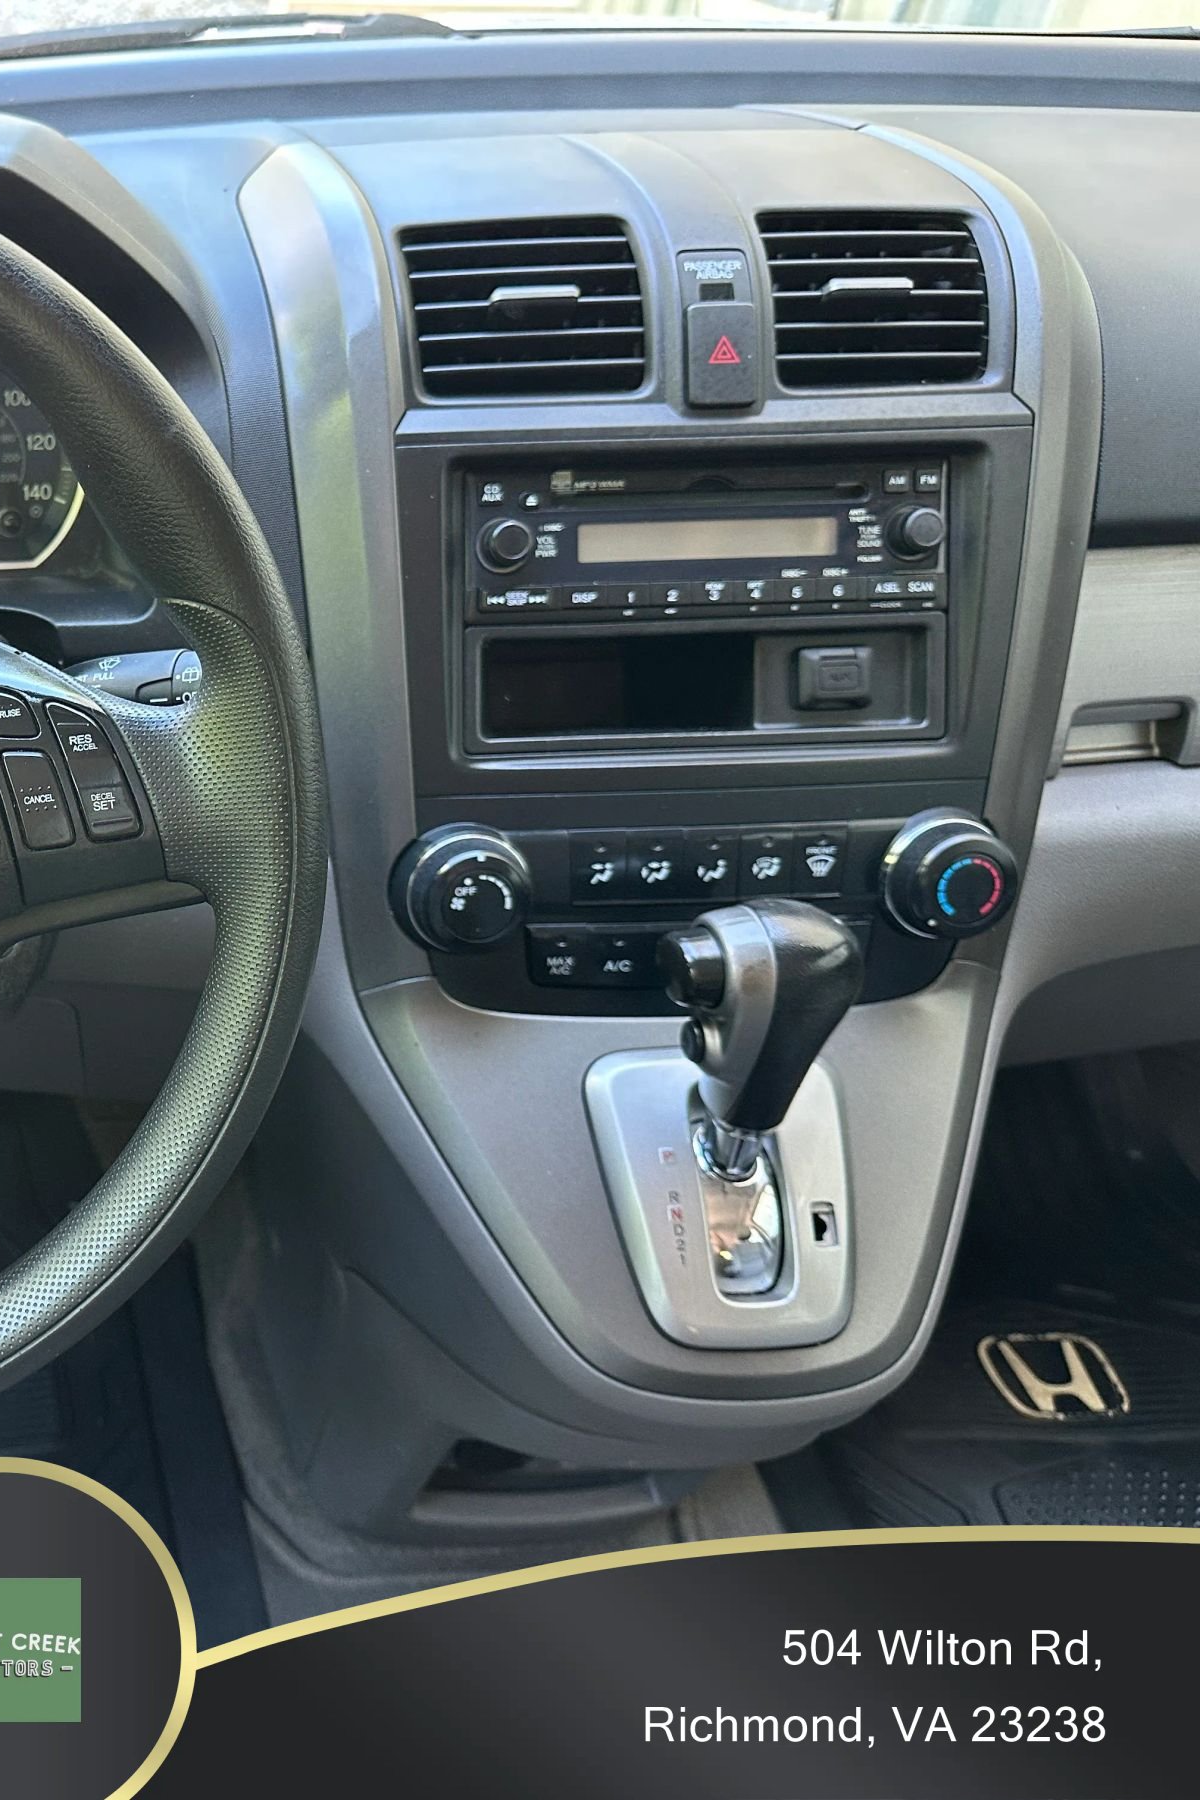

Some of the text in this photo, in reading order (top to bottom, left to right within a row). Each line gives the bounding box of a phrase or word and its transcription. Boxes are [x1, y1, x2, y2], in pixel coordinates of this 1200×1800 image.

[684, 260, 743, 272] PASSENGER
[696, 270, 735, 280] AIRBAG
[27, 434, 56, 452] 120
[888, 476, 906, 486] AM
[920, 474, 938, 485] FM
[23, 484, 53, 502] 140
[483, 483, 502, 494] CD
[481, 493, 504, 502] AUX
[536, 534, 556, 545] VOL
[791, 586, 804, 599] 5
[832, 584, 845, 597] 6
[907, 581, 935, 593] SCAN
[572, 592, 599, 603] DISP
[627, 591, 636, 603] 1
[666, 588, 680, 602] 2
[708, 589, 721, 601] 3
[750, 588, 762, 599] 4
[69, 733, 93, 746] RES
[73, 743, 98, 752] ACCEL
[24, 794, 55, 805] CANCEL
[91, 792, 116, 801] DECEL
[93, 800, 116, 811] SET
[454, 886, 477, 897] OFF
[546, 956, 575, 967] MAX
[603, 960, 632, 973] A/C
[673, 1223, 685, 1236] D
